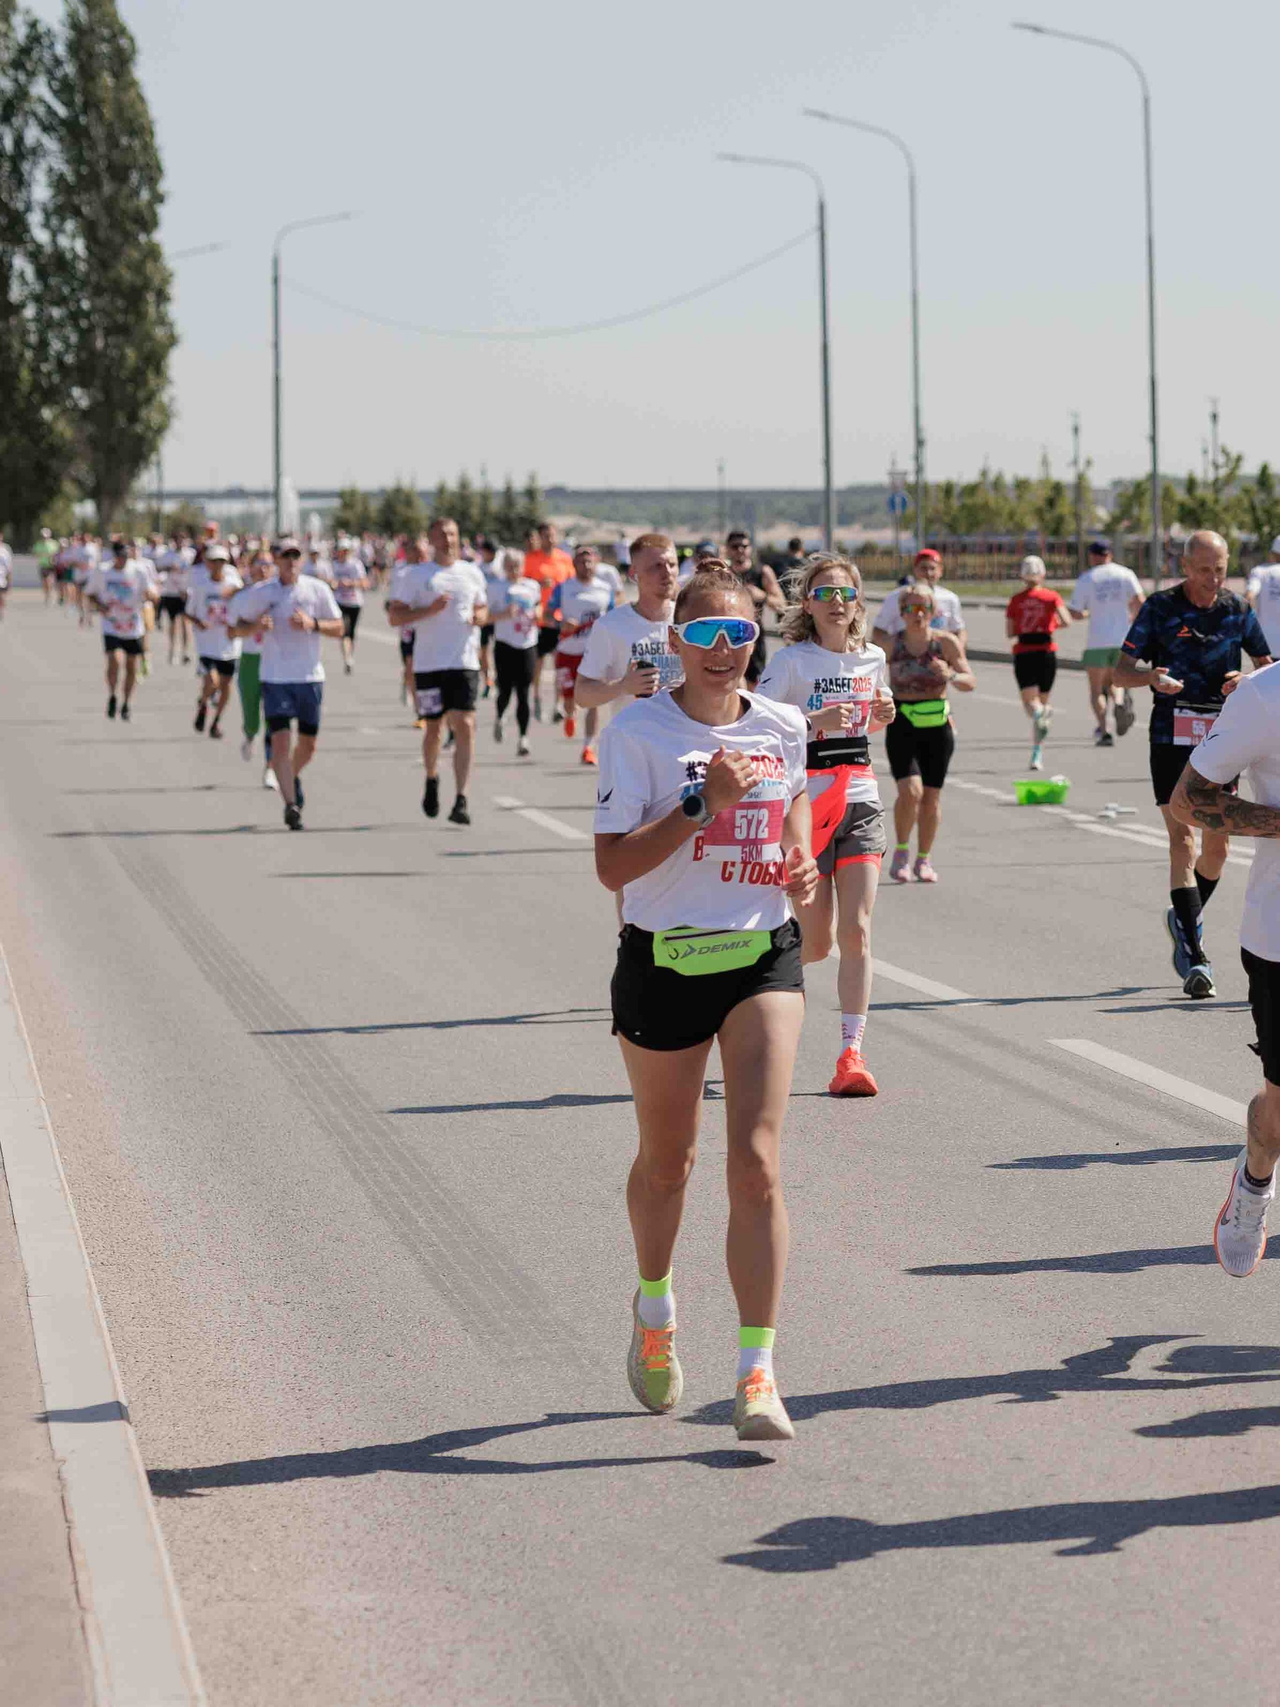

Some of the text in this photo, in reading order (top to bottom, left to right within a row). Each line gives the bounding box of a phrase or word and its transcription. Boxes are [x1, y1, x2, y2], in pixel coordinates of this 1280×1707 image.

[814, 677, 872, 693] #ЗАБЕГ2025
[734, 807, 769, 840] 572
[697, 939, 753, 955] DEMIX
